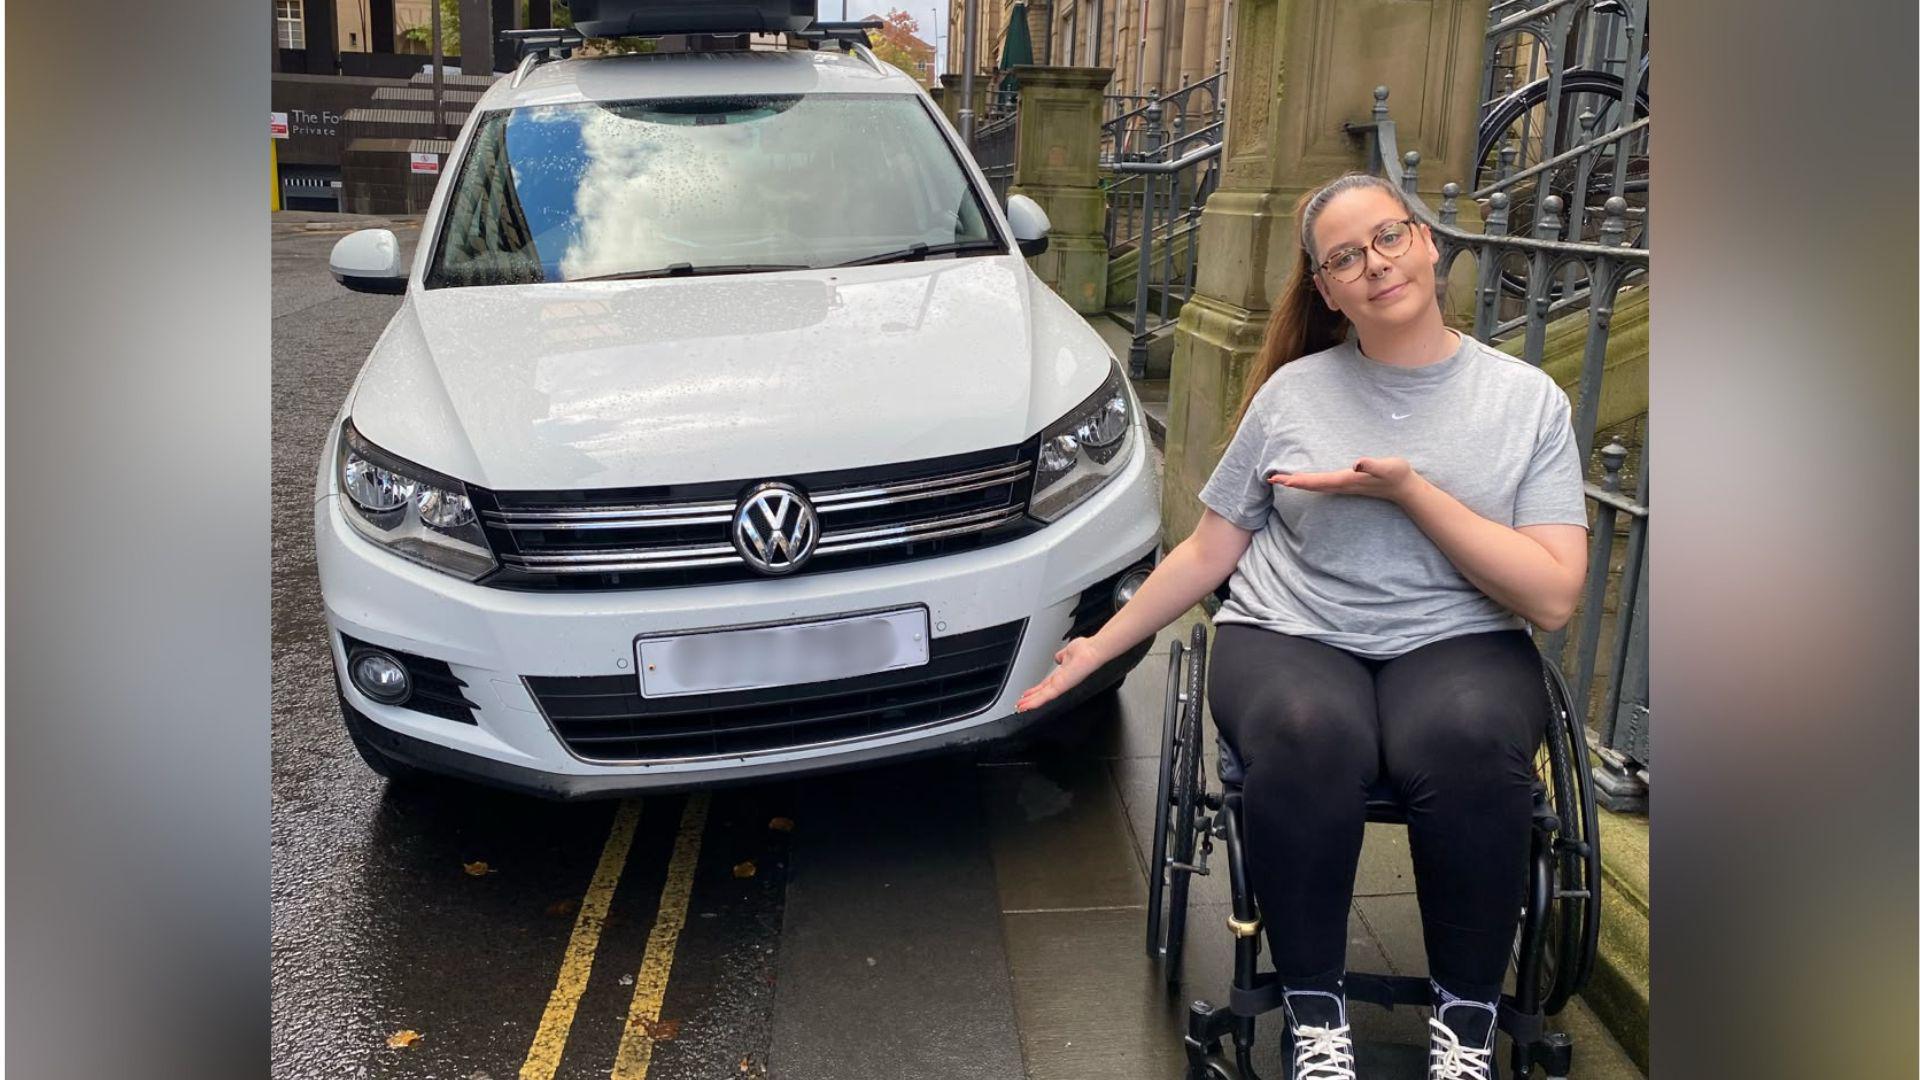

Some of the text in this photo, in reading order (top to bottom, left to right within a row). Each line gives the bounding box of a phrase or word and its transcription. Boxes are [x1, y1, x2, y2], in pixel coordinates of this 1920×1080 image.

[292, 109, 318, 124] The
[292, 125, 336, 136] Private
[737, 489, 815, 569] VW
